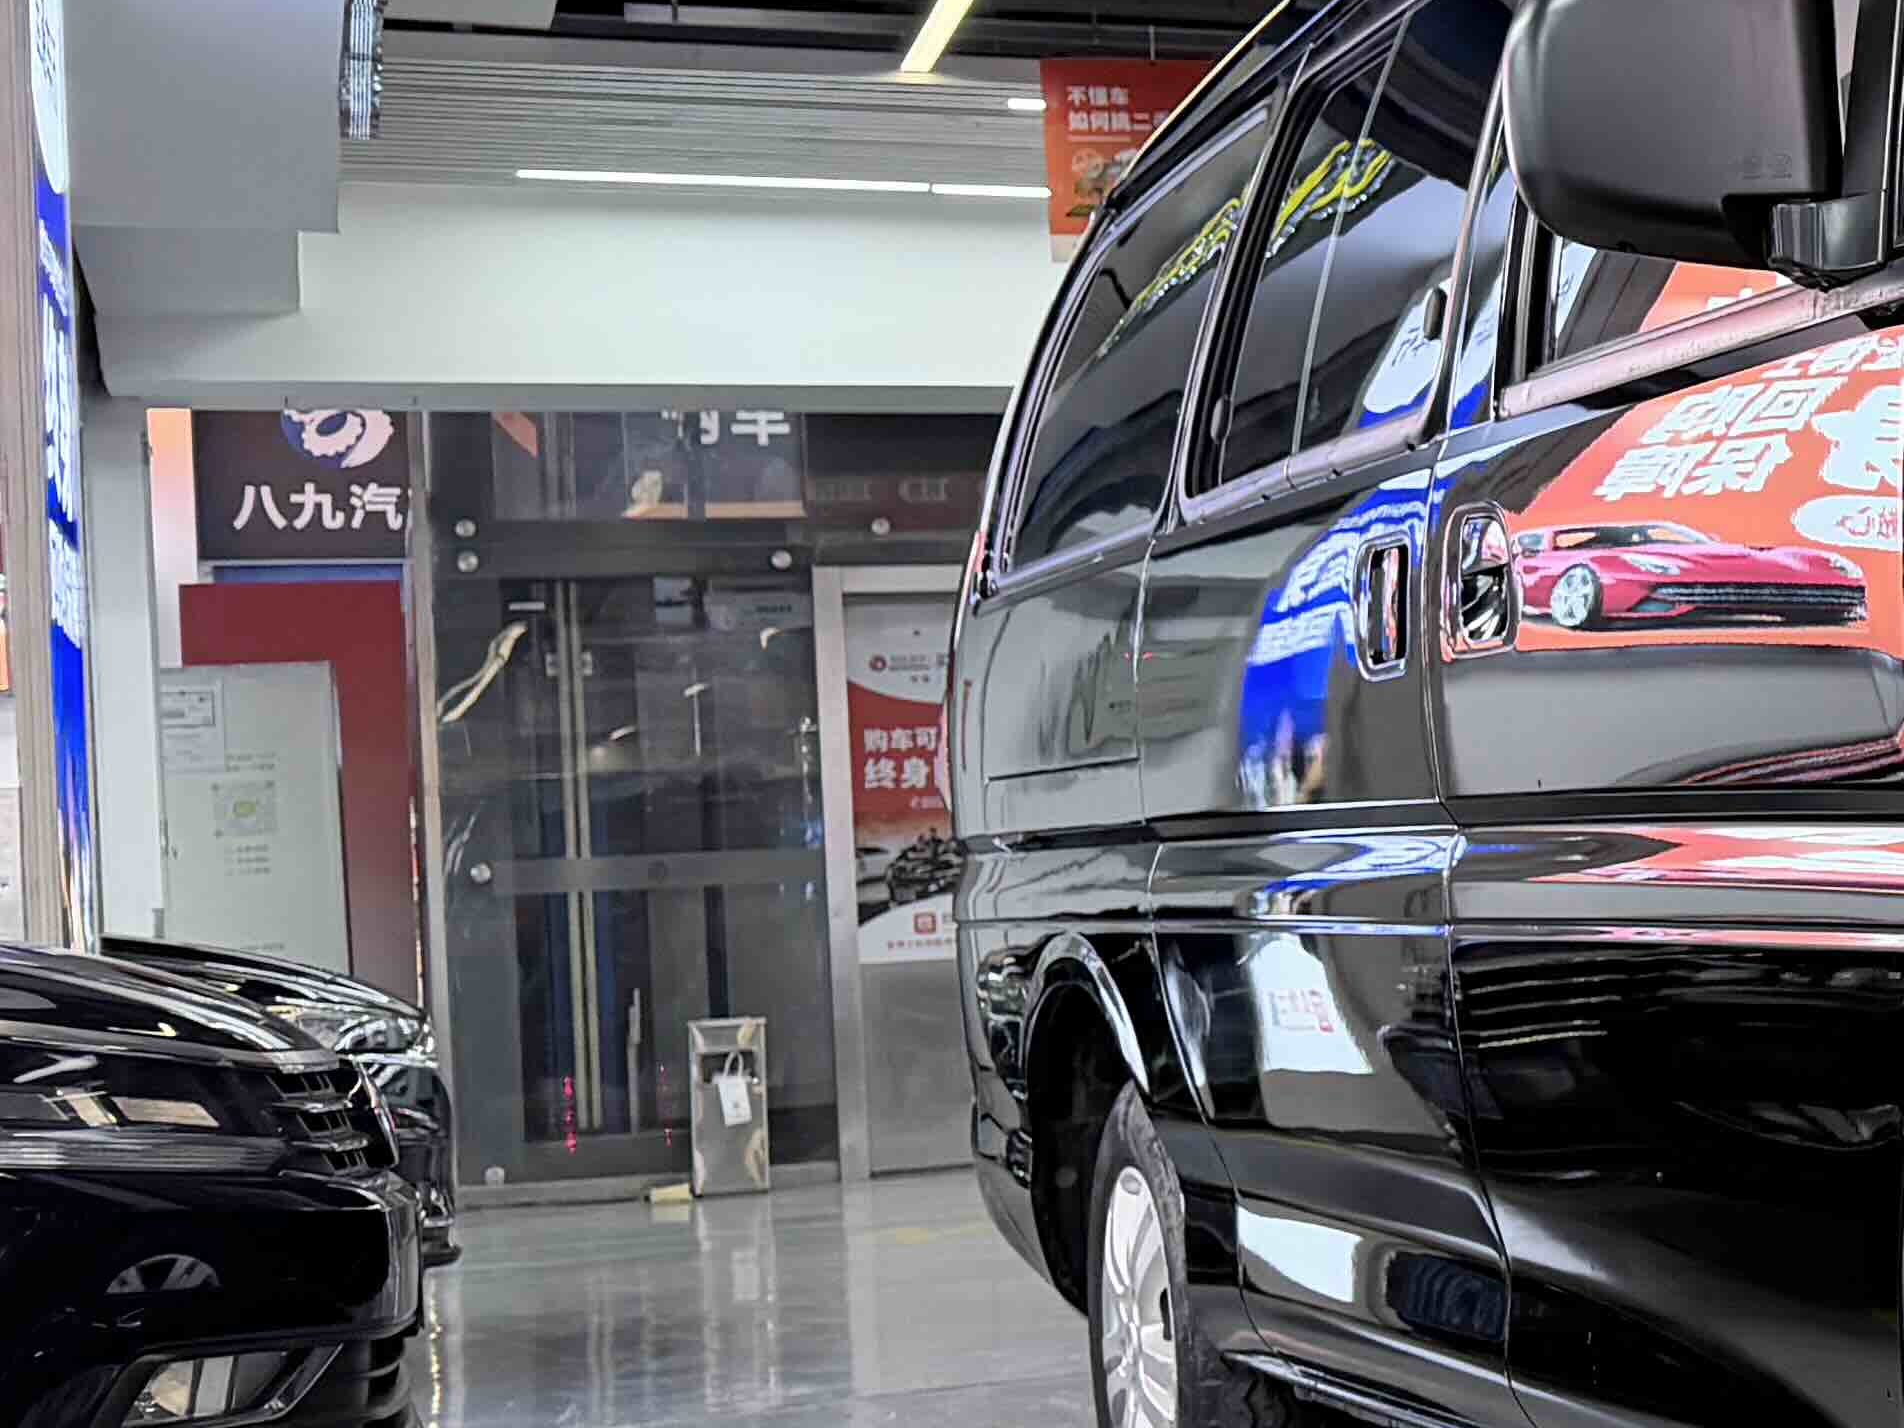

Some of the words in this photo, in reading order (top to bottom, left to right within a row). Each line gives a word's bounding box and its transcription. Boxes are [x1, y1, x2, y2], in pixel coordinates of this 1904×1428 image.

[233, 481, 412, 531] 八九汽
[863, 758, 930, 790] 终身
